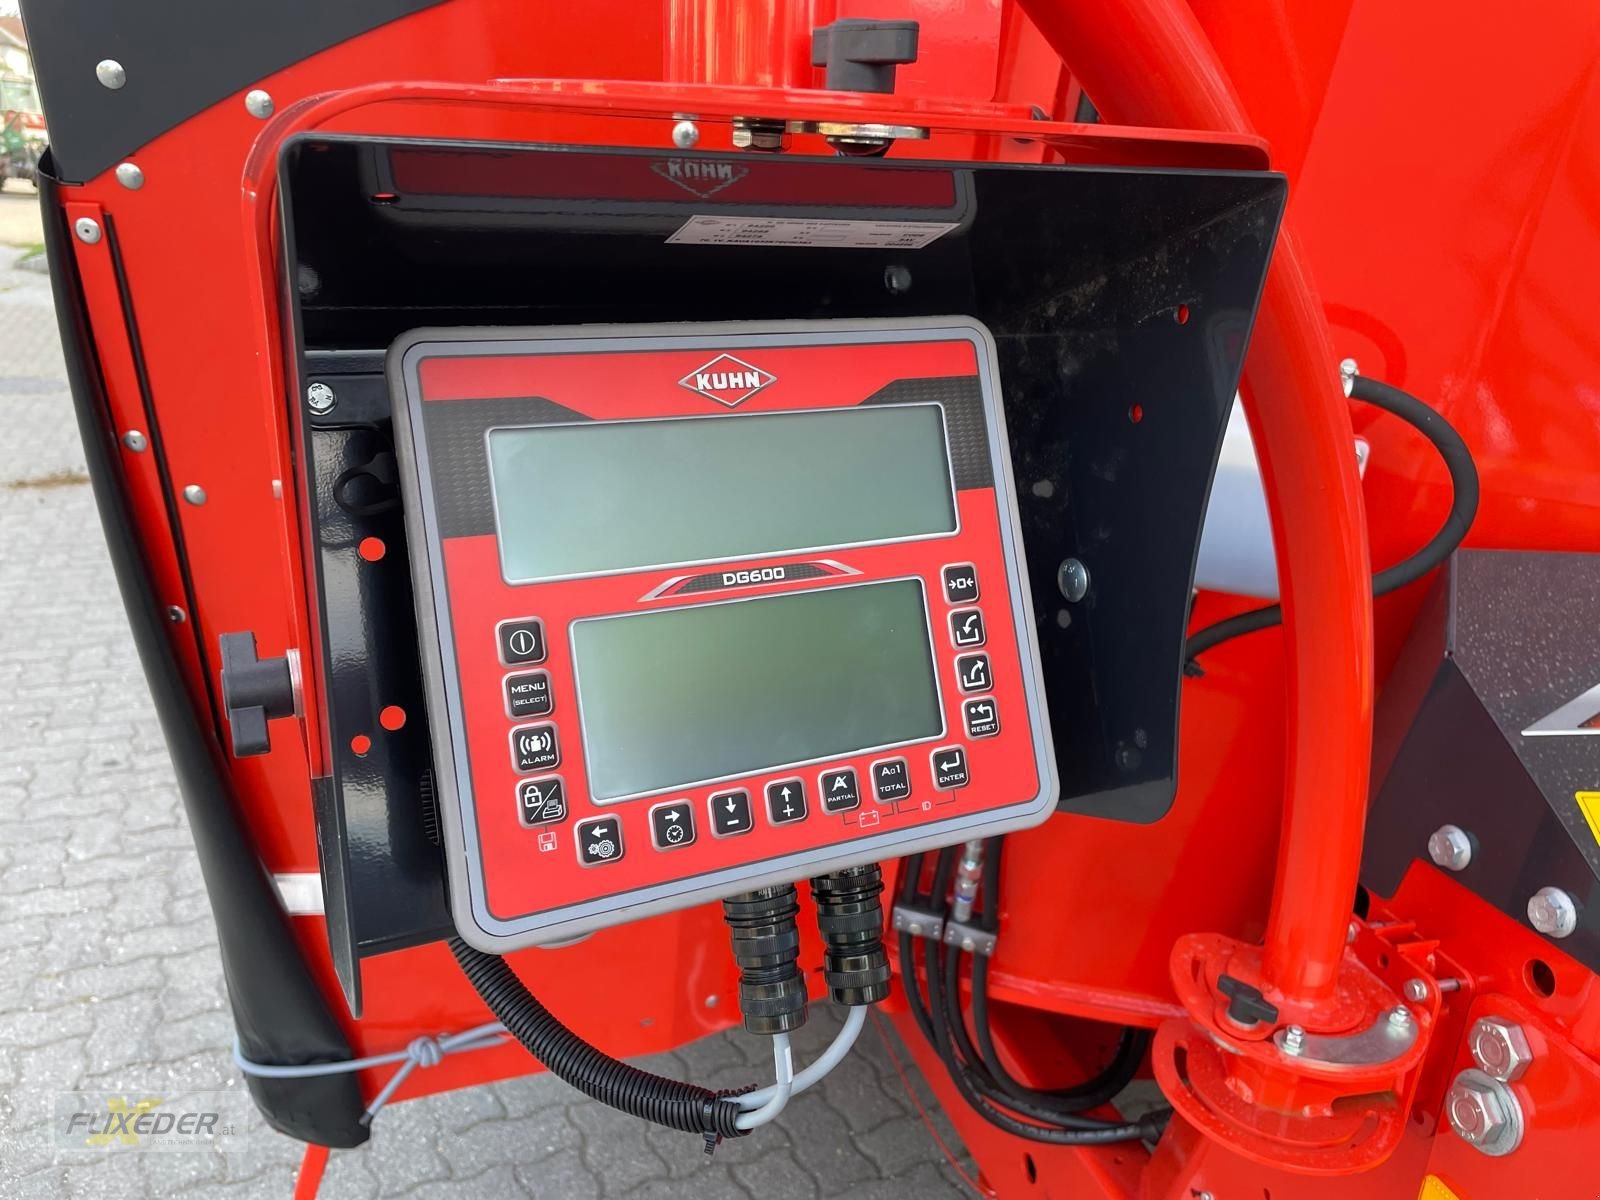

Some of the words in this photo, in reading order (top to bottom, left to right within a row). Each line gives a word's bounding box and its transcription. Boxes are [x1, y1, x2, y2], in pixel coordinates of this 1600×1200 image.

[696, 371, 760, 390] KUHN
[722, 567, 785, 586] DG600
[511, 682, 546, 694] MENU
[970, 723, 996, 734] RESET
[521, 754, 555, 766] ALARM
[939, 772, 965, 784] ENTER
[880, 782, 906, 793] TOTAL
[827, 793, 856, 804] PARTIAL
